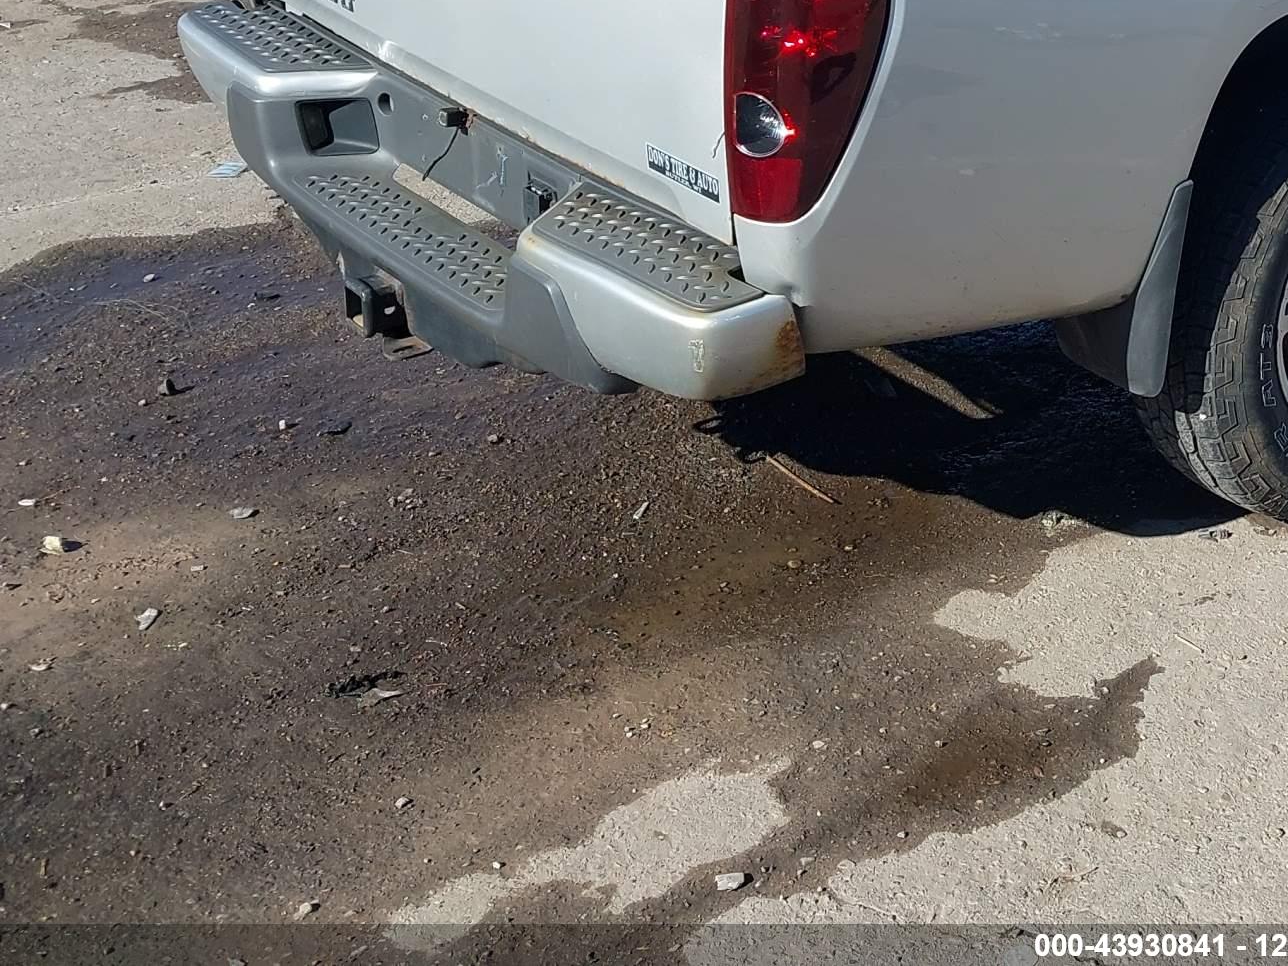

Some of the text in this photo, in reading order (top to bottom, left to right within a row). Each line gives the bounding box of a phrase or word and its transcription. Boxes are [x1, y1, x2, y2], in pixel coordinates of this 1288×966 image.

[670, 158, 688, 180] TIRE
[688, 166, 696, 184] &
[697, 171, 719, 195] AUTO
